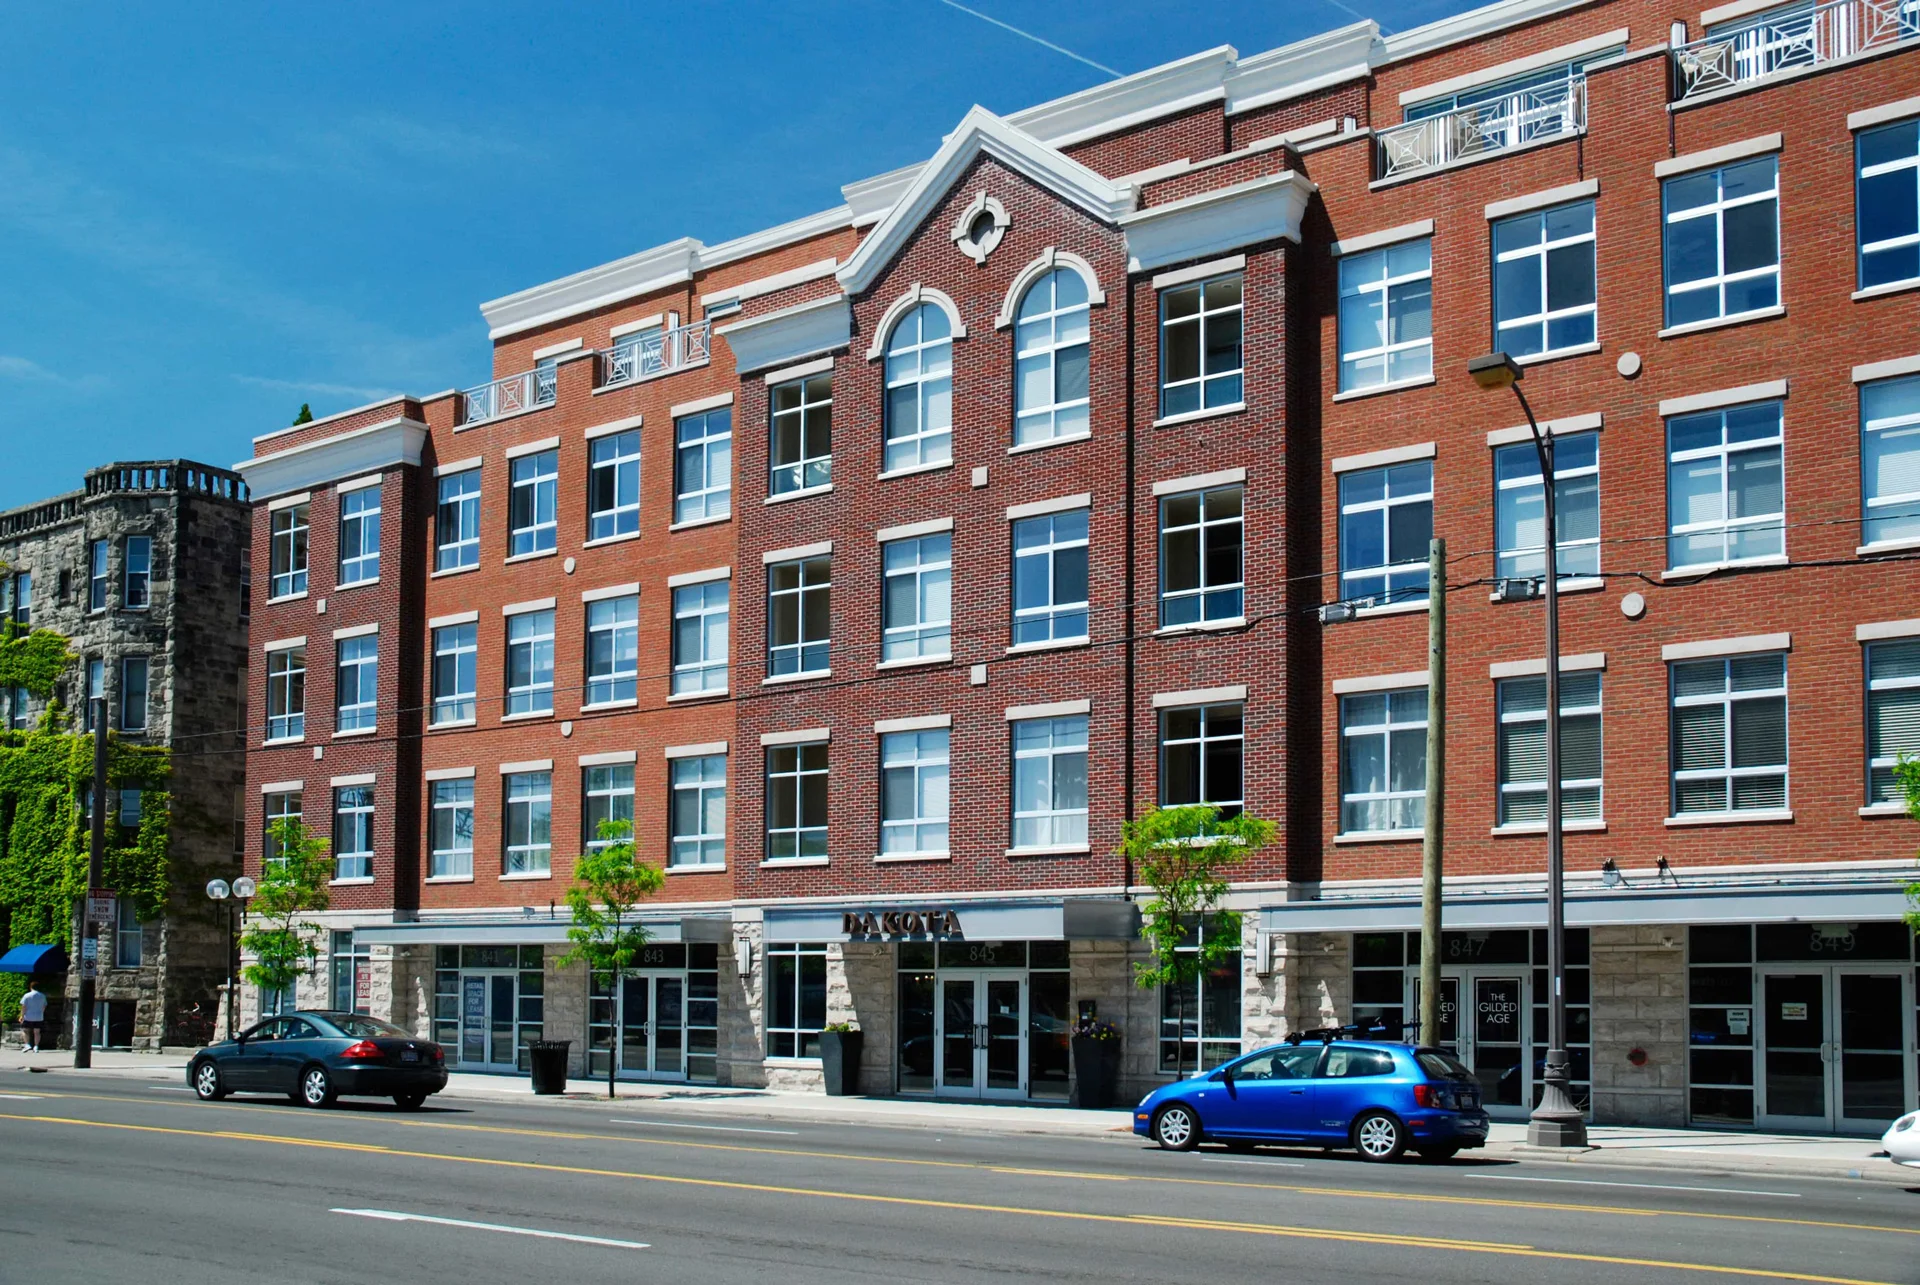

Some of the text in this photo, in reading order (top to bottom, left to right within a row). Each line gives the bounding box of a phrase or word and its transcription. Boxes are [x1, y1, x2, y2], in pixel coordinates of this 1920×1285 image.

[841, 909, 963, 935] DAKOTA
[1450, 938, 1486, 957] 847
[1810, 931, 1856, 952] 849
[481, 950, 499, 963] 841
[643, 949, 664, 963] 843
[969, 945, 995, 962] 845
[357, 989, 370, 997] LEAS
[1490, 993, 1506, 1001] THE
[467, 1005, 484, 1013] LEASE
[1478, 1002, 1517, 1013] GILDED
[1486, 1013, 1510, 1024] AGE
